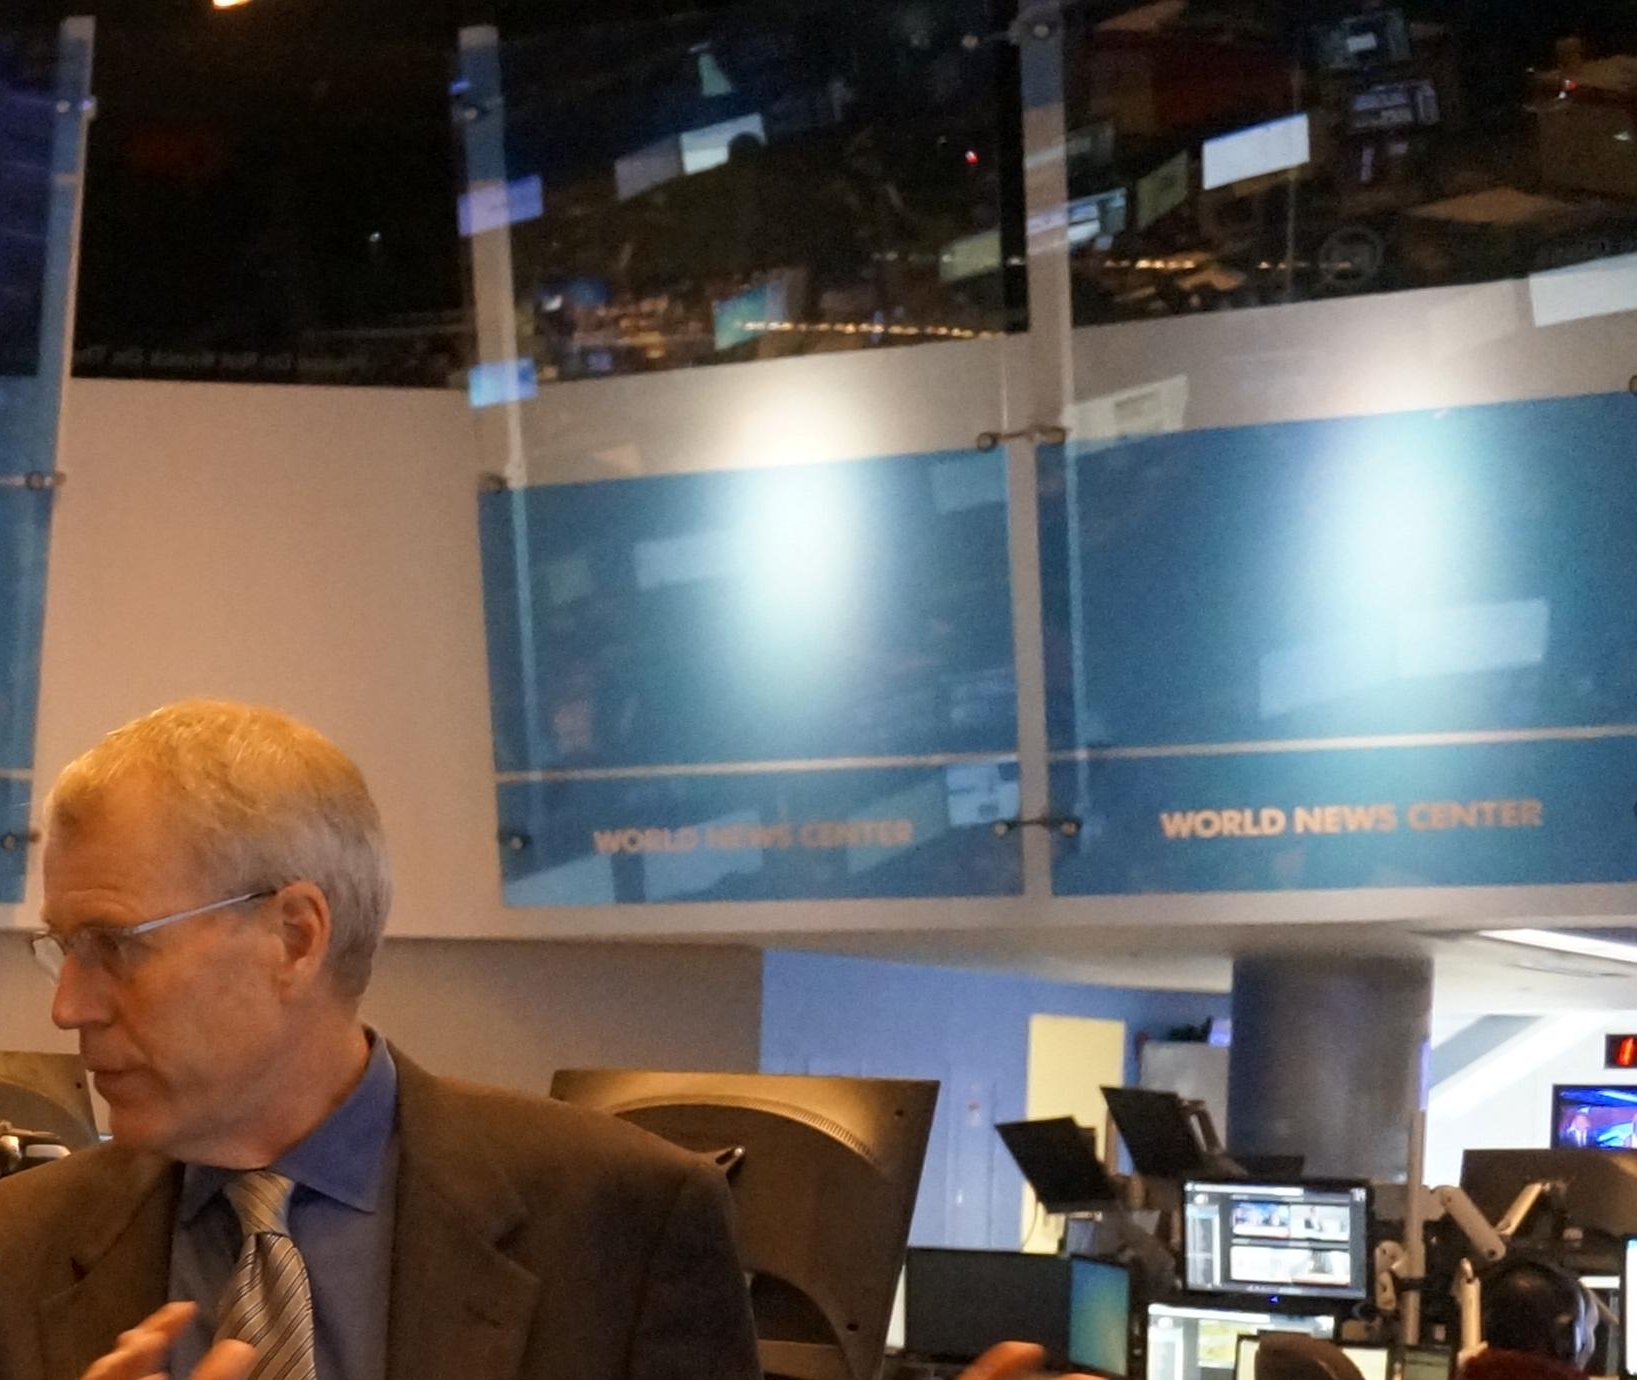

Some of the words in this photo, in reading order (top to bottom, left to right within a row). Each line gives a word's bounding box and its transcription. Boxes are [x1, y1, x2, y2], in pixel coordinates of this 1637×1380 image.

[593, 826, 698, 854] WORLD
[706, 823, 792, 849] NEWS
[800, 819, 913, 849] CENTER
[1160, 808, 1287, 839] WORLD
[1294, 804, 1398, 833] NEWS
[1407, 799, 1543, 832] CENTER
